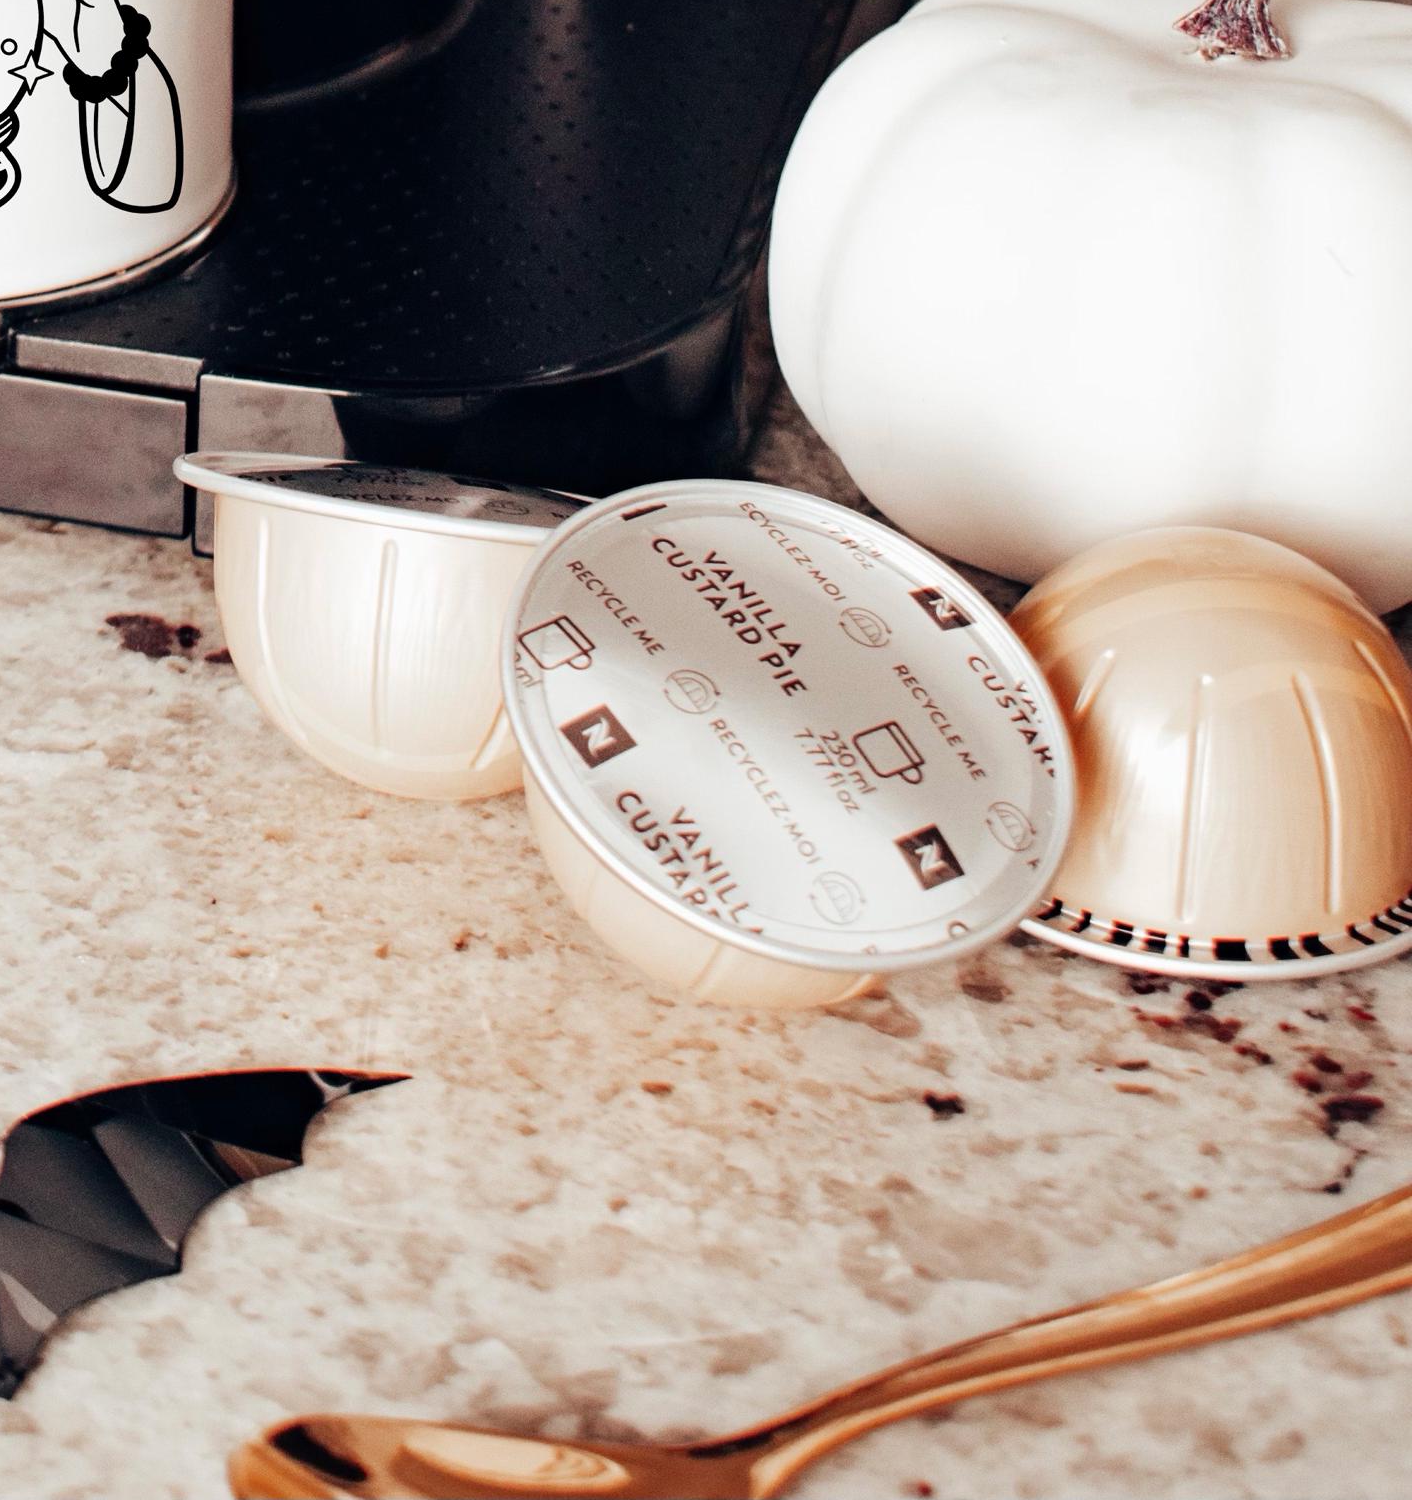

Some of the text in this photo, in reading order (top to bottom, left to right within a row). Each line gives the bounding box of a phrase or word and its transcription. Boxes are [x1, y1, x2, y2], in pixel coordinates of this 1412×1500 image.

[566, 559, 666, 657] RECYCLE ME
[651, 537, 808, 697] CUSTARD PIE
[704, 550, 802, 658] VANILLA
[793, 726, 861, 816] 7.77 fl oz
[818, 730, 878, 794] 230 ml
[891, 663, 987, 781] RECYCLE ME
[709, 718, 822, 864] RECYCLEZ-MOI
[670, 805, 764, 934] VANILL
